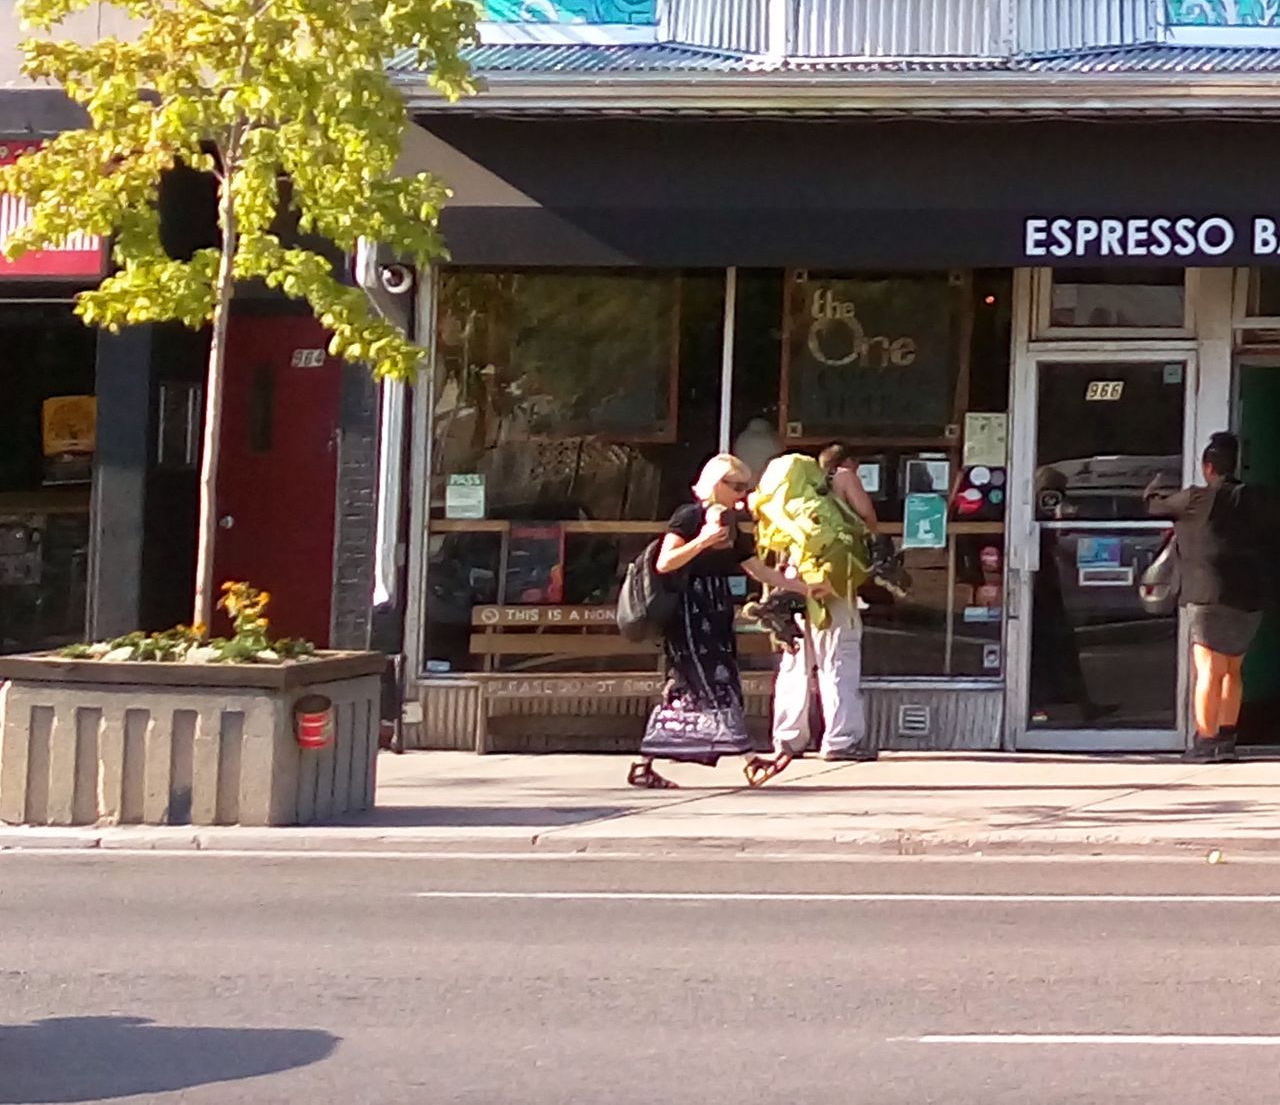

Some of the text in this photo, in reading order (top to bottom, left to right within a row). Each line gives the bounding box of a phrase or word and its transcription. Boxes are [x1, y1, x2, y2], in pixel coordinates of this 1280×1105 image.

[1025, 217, 1235, 257] ESPRESSO
[811, 287, 855, 318] the
[1087, 382, 1122, 399] 966
[505, 609, 539, 622] THIS
[548, 609, 562, 621] IS
[569, 610, 580, 621] A
